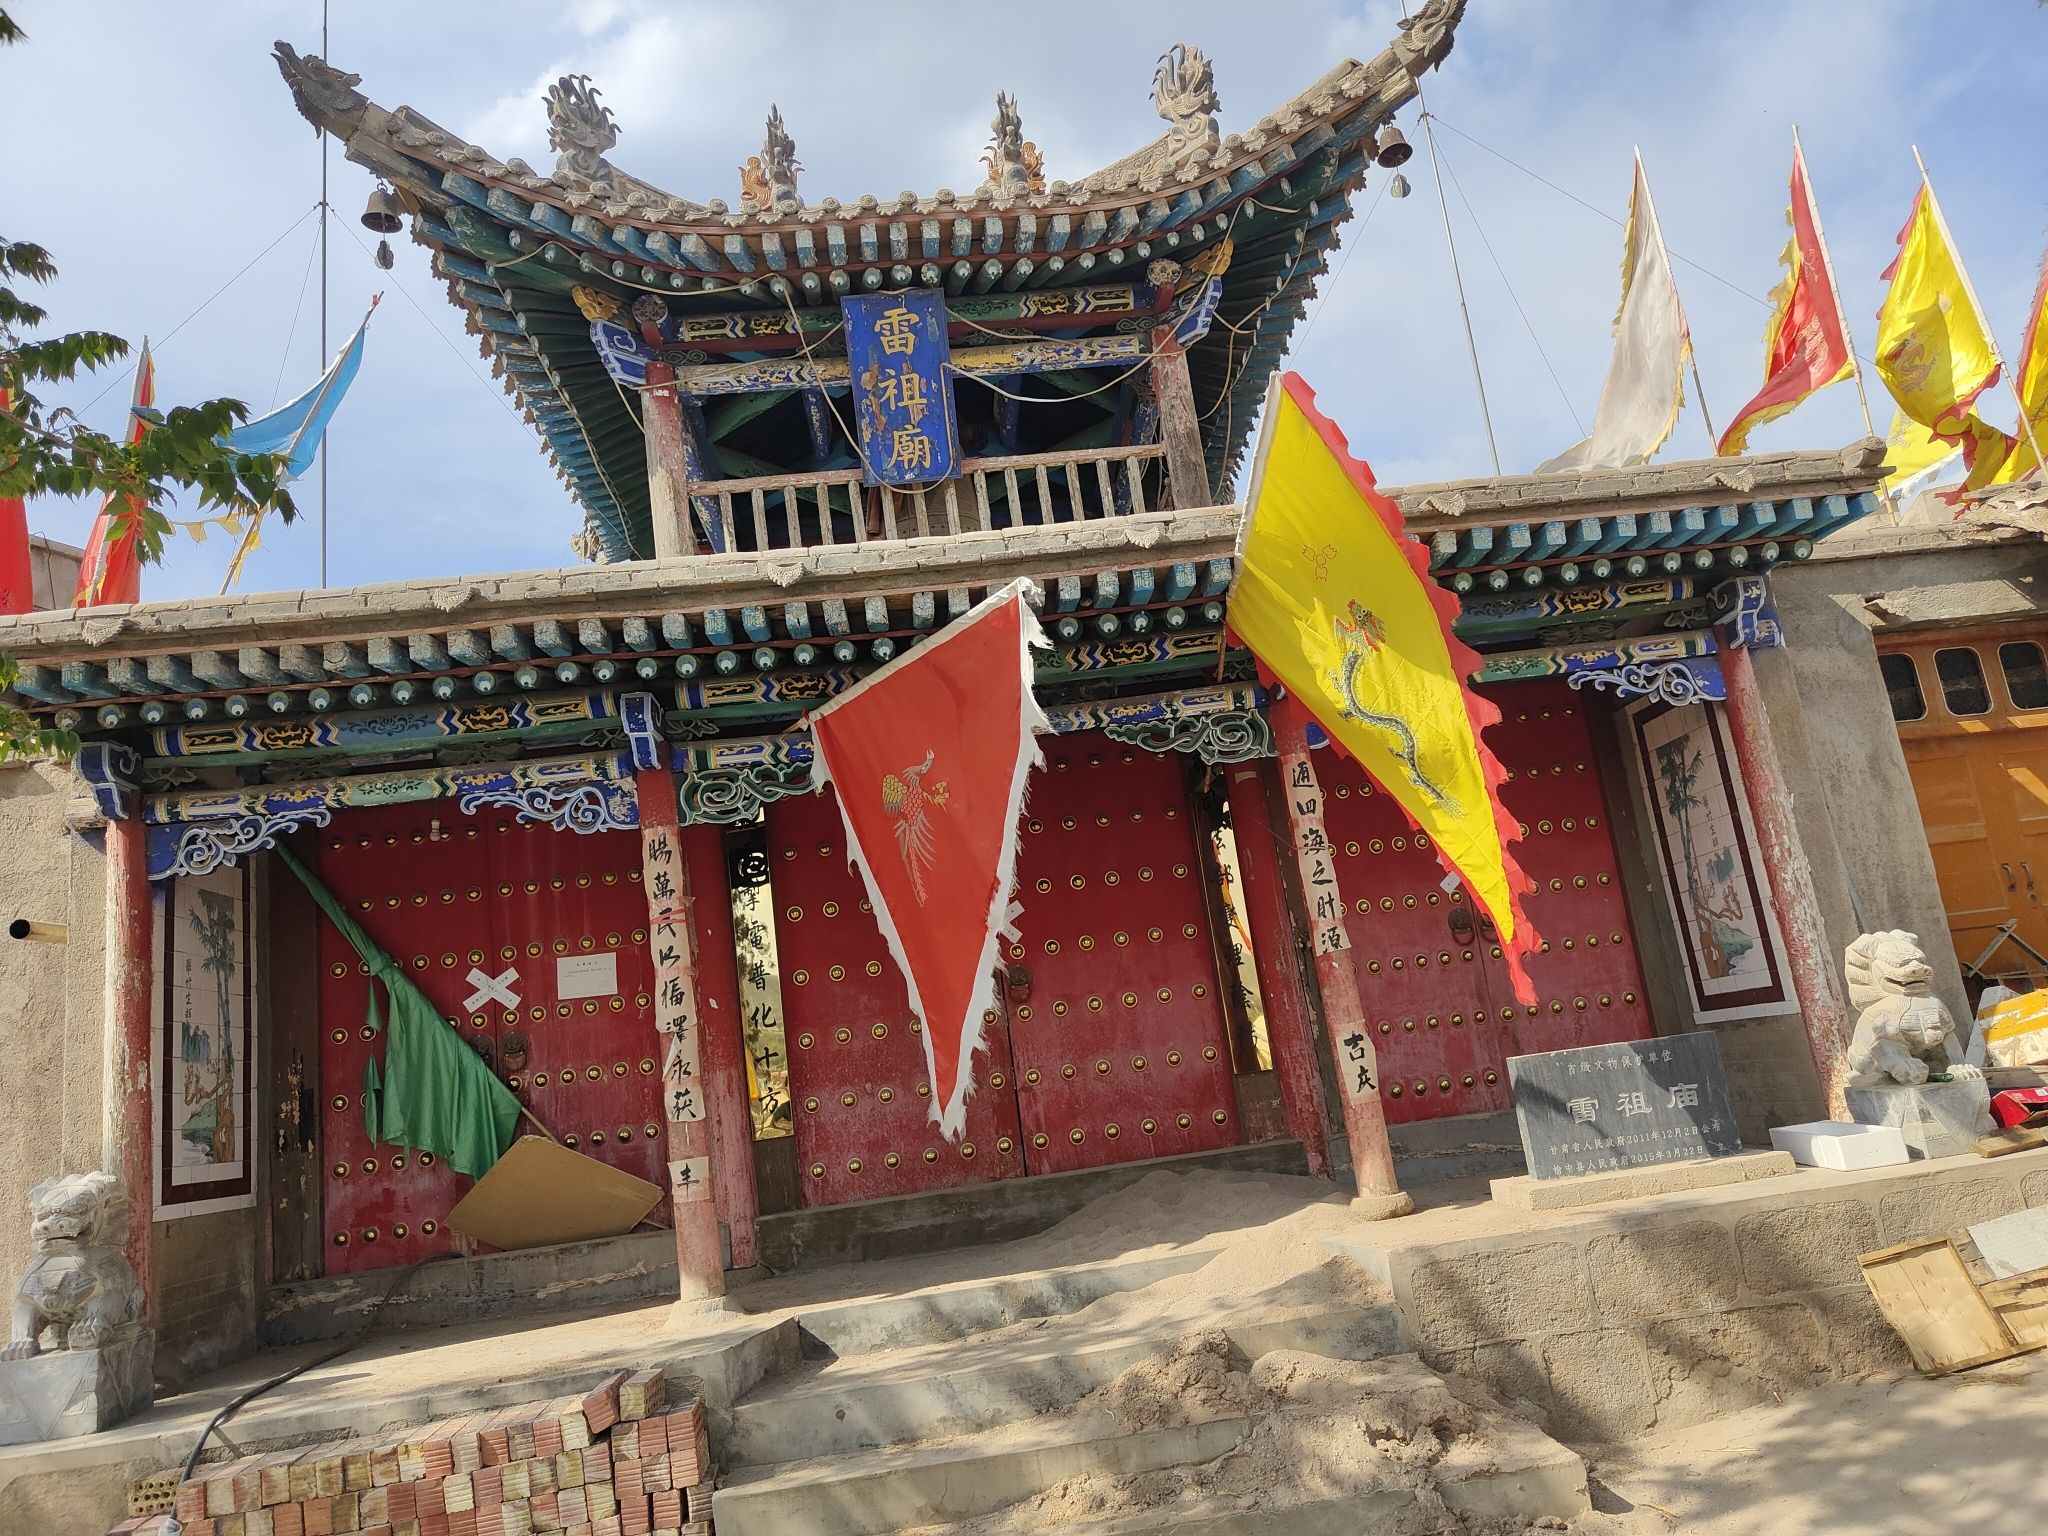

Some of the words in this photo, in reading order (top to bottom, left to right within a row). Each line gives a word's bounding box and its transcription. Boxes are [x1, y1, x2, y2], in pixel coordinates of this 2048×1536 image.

[874, 307, 931, 470] 雷祖廟
[1567, 1049, 1673, 1076] 省级文物保护单位
[1566, 1082, 1700, 1124] 雷祖庙
